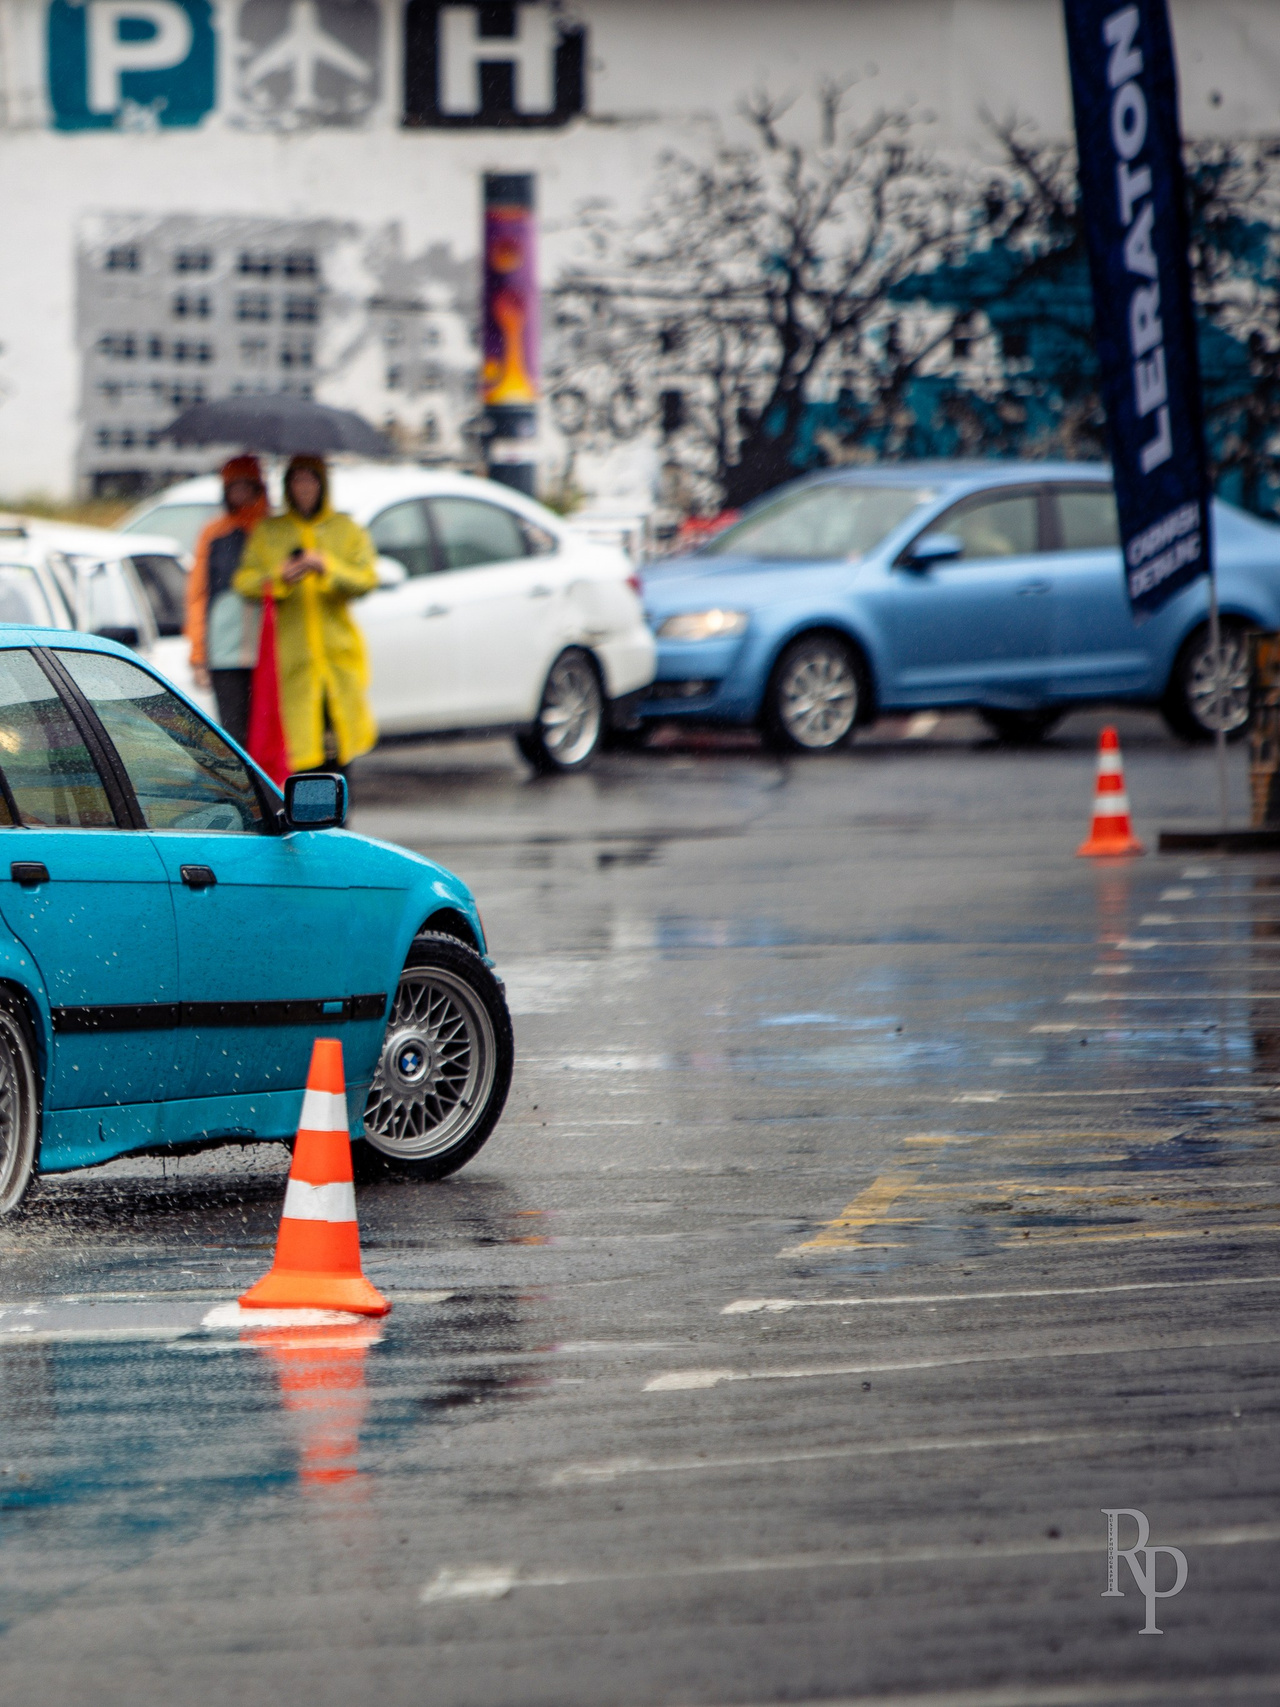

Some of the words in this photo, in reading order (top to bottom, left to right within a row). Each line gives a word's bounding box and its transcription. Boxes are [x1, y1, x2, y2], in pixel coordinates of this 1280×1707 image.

[86, 0, 193, 115] P
[440, 8, 557, 117] H
[1103, 3, 1173, 475] LERATON
